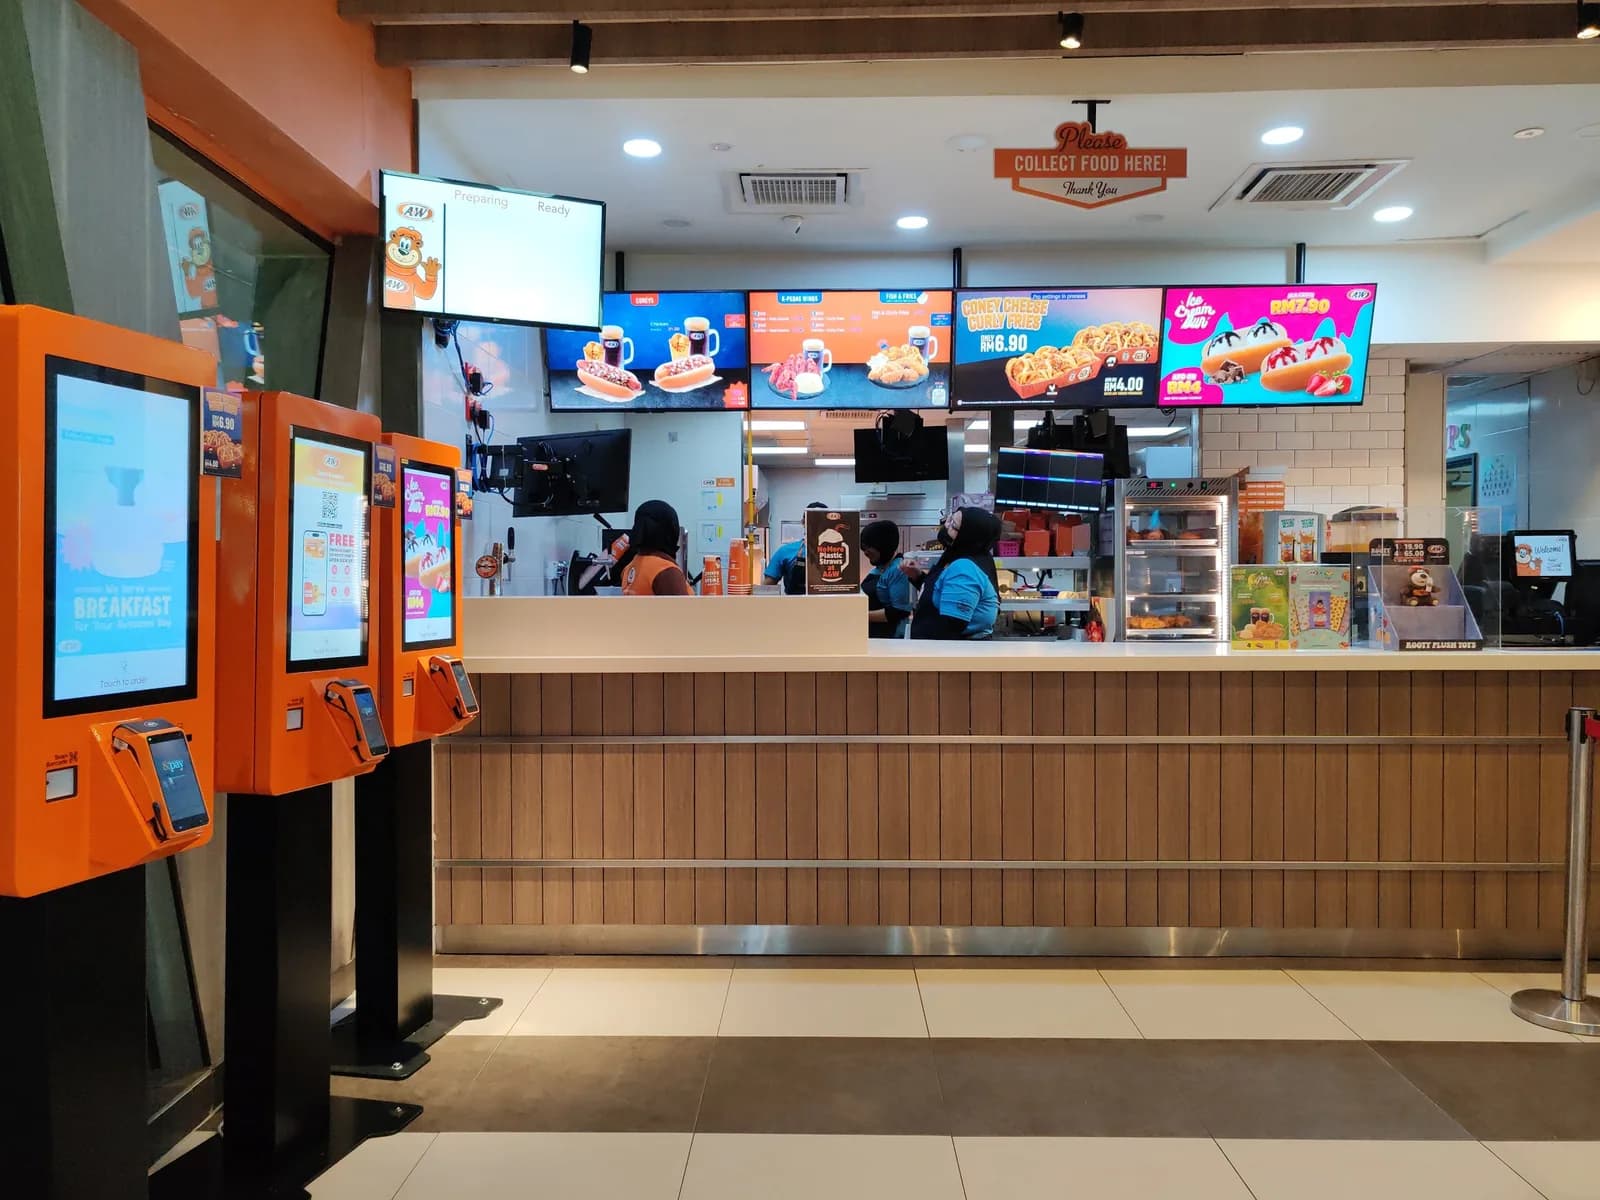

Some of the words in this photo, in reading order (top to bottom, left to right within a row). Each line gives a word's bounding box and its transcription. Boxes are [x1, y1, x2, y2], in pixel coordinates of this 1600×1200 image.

[1059, 126, 1123, 152] Please
[1014, 154, 1076, 172] COLLECT
[1081, 154, 1120, 172] FOOD
[1125, 154, 1167, 172] HERE!
[1062, 181, 1095, 197] Thank
[1095, 181, 1119, 199] You
[453, 190, 509, 210] Preparing
[537, 201, 571, 218] Ready
[885, 292, 897, 300] FISH
[903, 292, 917, 300] FRIES
[1186, 291, 1203, 307] Ice
[962, 297, 1003, 316] CONEY
[1003, 297, 1049, 315] CHEESE
[1174, 304, 1216, 318] Cream
[1270, 298, 1331, 315] RM7.90
[968, 313, 1007, 331] CURLY
[1006, 313, 1043, 331] FRIES
[1180, 313, 1209, 329] Bun
[329, 533, 354, 547] FREE
[73, 595, 172, 619] BREAKFAST
[1405, 641, 1429, 649] ROOTY
[1432, 641, 1456, 649] PLUSH
[1458, 641, 1477, 649] TOYS
[100, 679, 121, 689] Touch
